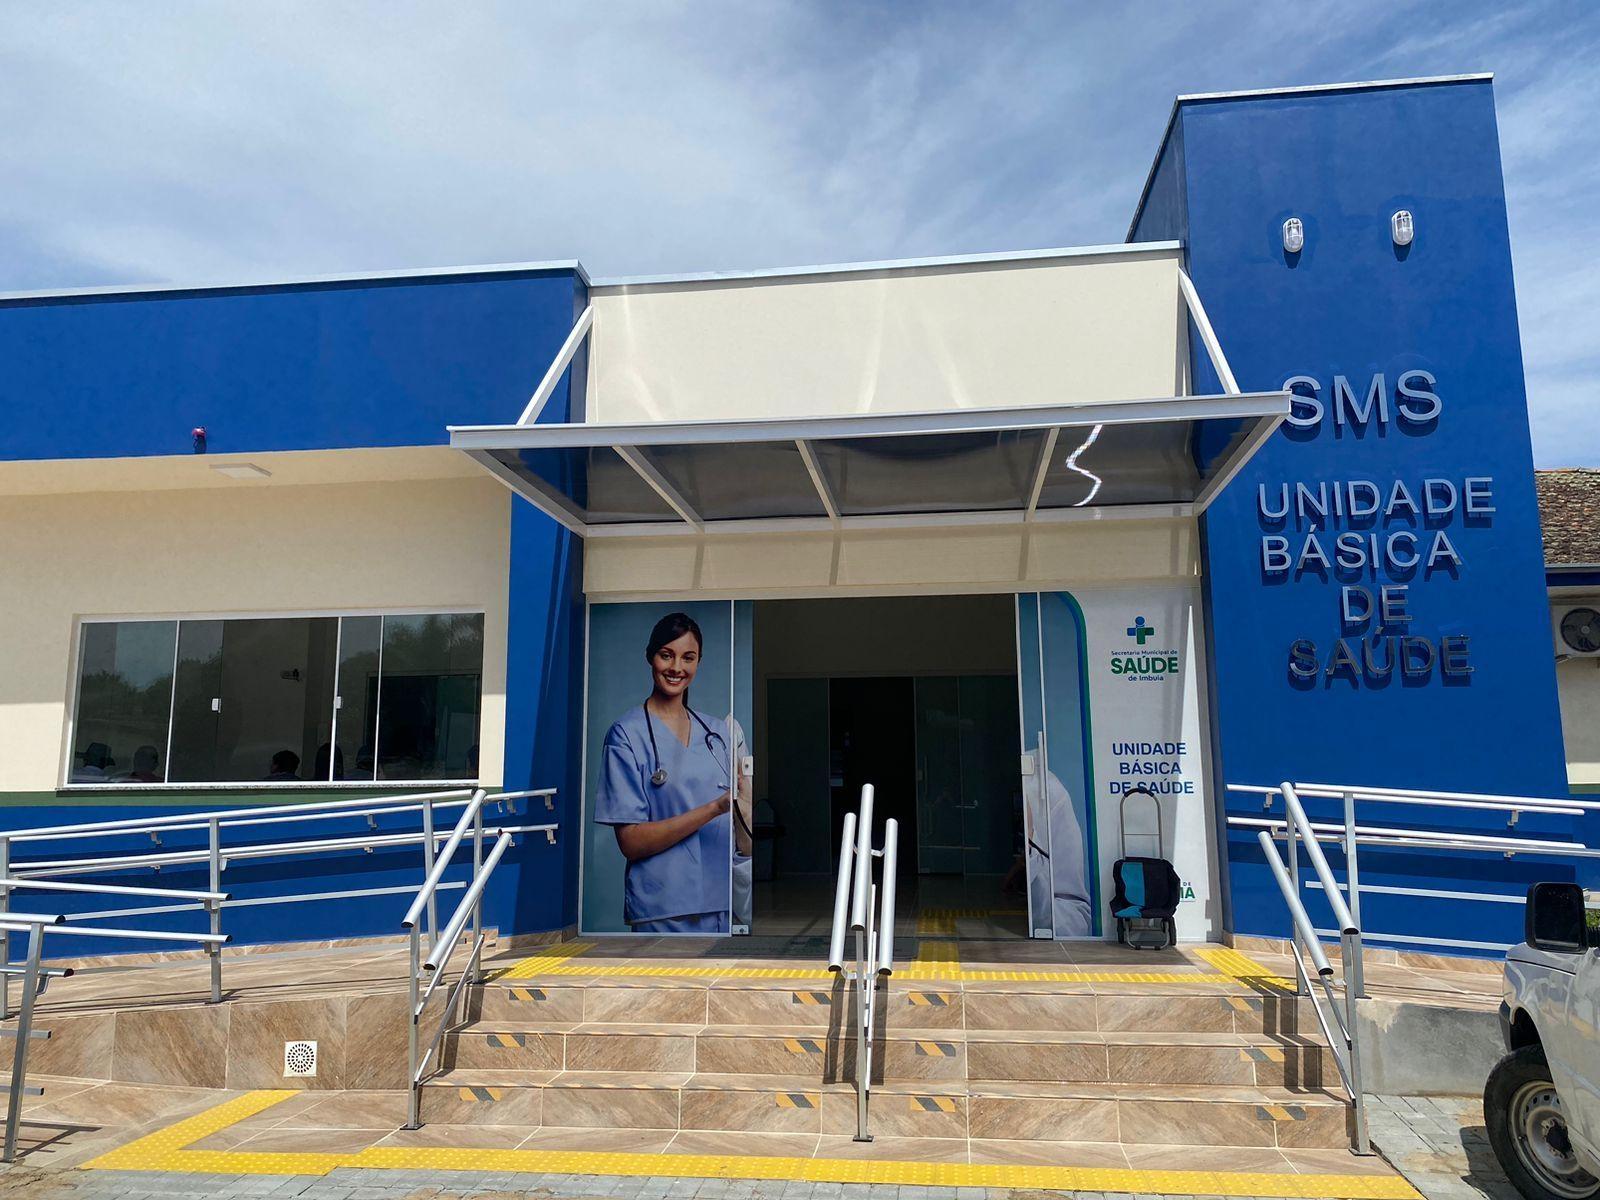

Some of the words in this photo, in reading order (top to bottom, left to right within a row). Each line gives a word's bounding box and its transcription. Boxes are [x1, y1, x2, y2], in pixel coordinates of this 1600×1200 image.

[1282, 369, 1442, 427] SMS
[1258, 477, 1496, 518] UNIDADE
[1262, 524, 1463, 571] BÁSICA
[1342, 585, 1412, 621] DE
[1110, 656, 1179, 674] SAÚDE
[1289, 626, 1475, 676] SAÚDE
[1112, 742, 1187, 755] UNIDADE
[1119, 759, 1182, 775] BÁSICA
[1109, 782, 1131, 794] DE
